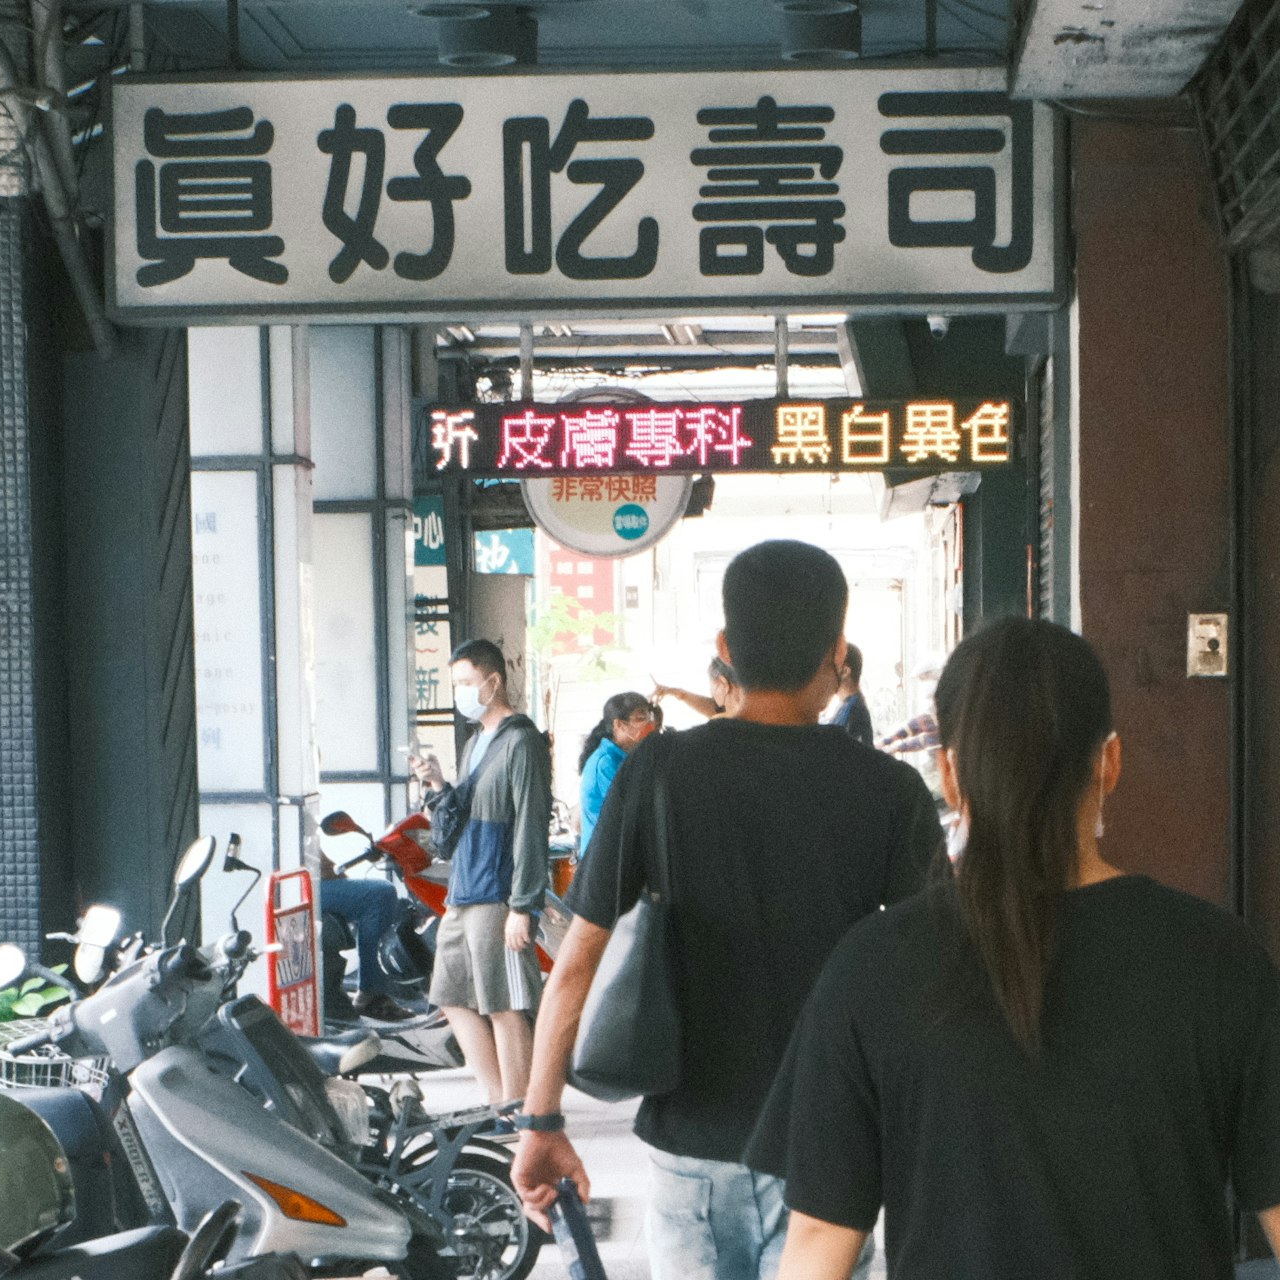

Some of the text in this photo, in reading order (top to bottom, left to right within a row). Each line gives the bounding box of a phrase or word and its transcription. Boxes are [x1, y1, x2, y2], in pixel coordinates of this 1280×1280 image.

[496, 407, 753, 468] 皮膚專科
[771, 402, 1008, 464] 黑白異色
